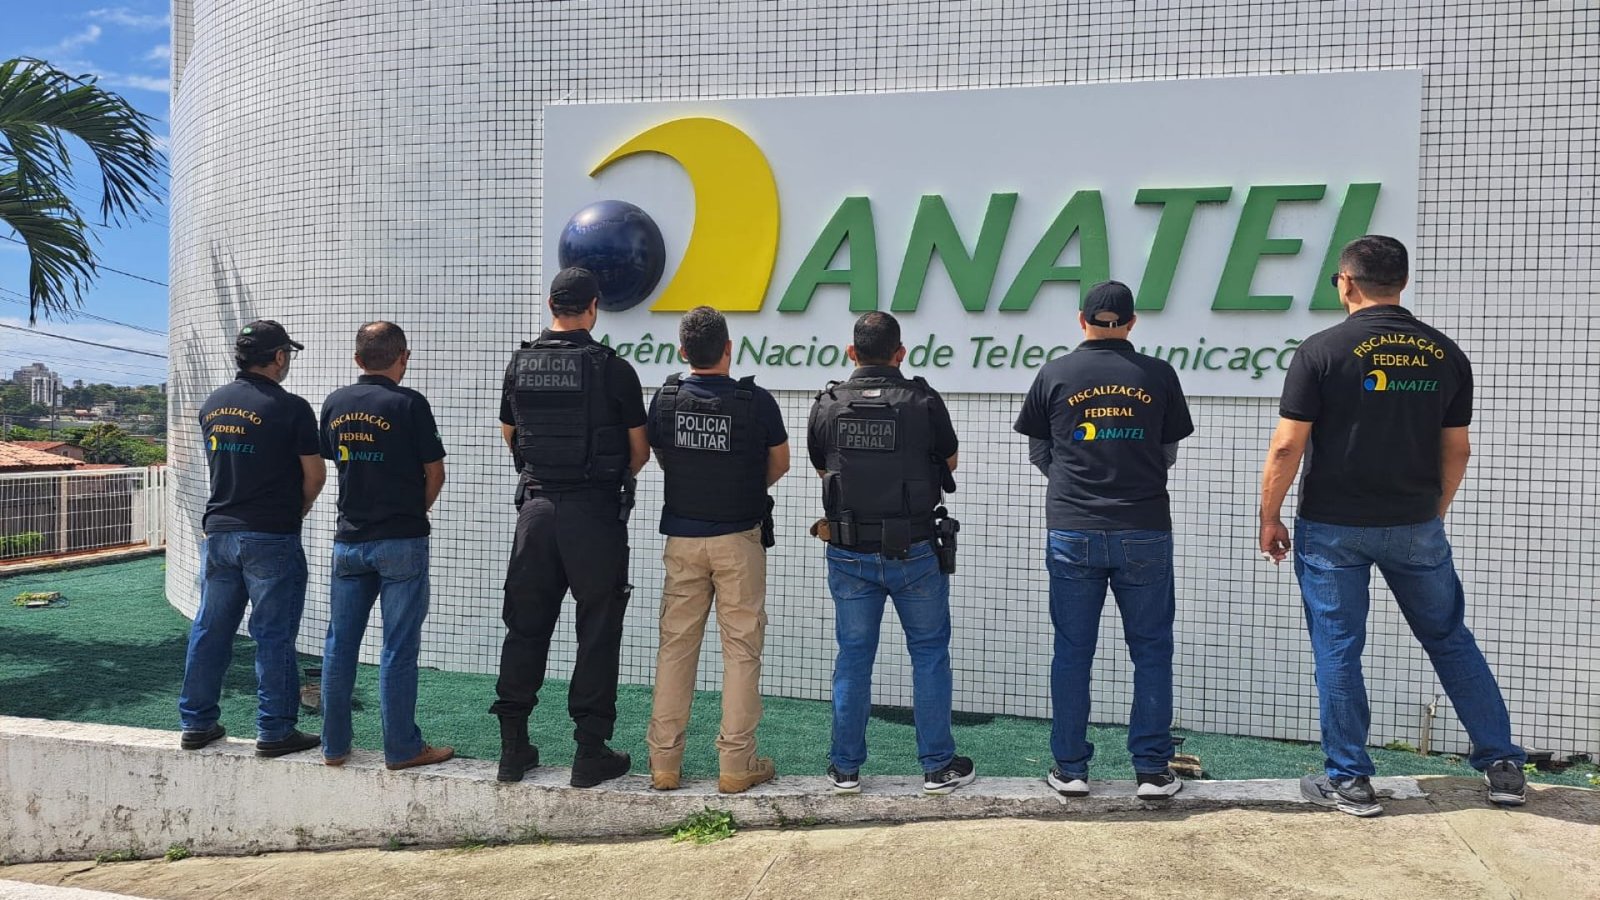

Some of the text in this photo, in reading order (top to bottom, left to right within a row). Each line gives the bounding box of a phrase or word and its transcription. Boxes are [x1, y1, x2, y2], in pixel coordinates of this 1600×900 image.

[776, 182, 1382, 312] ANATEL
[735, 335, 850, 367] Nacio
[908, 333, 954, 367] de
[1353, 333, 1445, 360] FISCALIZAÇÃO
[519, 356, 577, 372] POLÍCIA
[1373, 354, 1429, 367] FEDERAL
[518, 374, 578, 387] FEDERAL
[1386, 379, 1440, 392] ANATEL
[1067, 384, 1152, 407] FISCALIZAÇÃO
[205, 407, 262, 426] FISCALIZAÇÃO
[1084, 407, 1135, 418] FEDERAL
[330, 411, 391, 431] FISCALIZAÇÃO
[212, 424, 247, 435] FEDERAL
[839, 421, 893, 436] POLÍCIA
[1095, 427, 1145, 440] ANATEL
[339, 431, 375, 442] FEDERAL
[677, 431, 727, 450] MILITAR
[846, 435, 886, 448] PENAL
[217, 442, 256, 454] ANATEL
[348, 451, 385, 462] ANATEL
